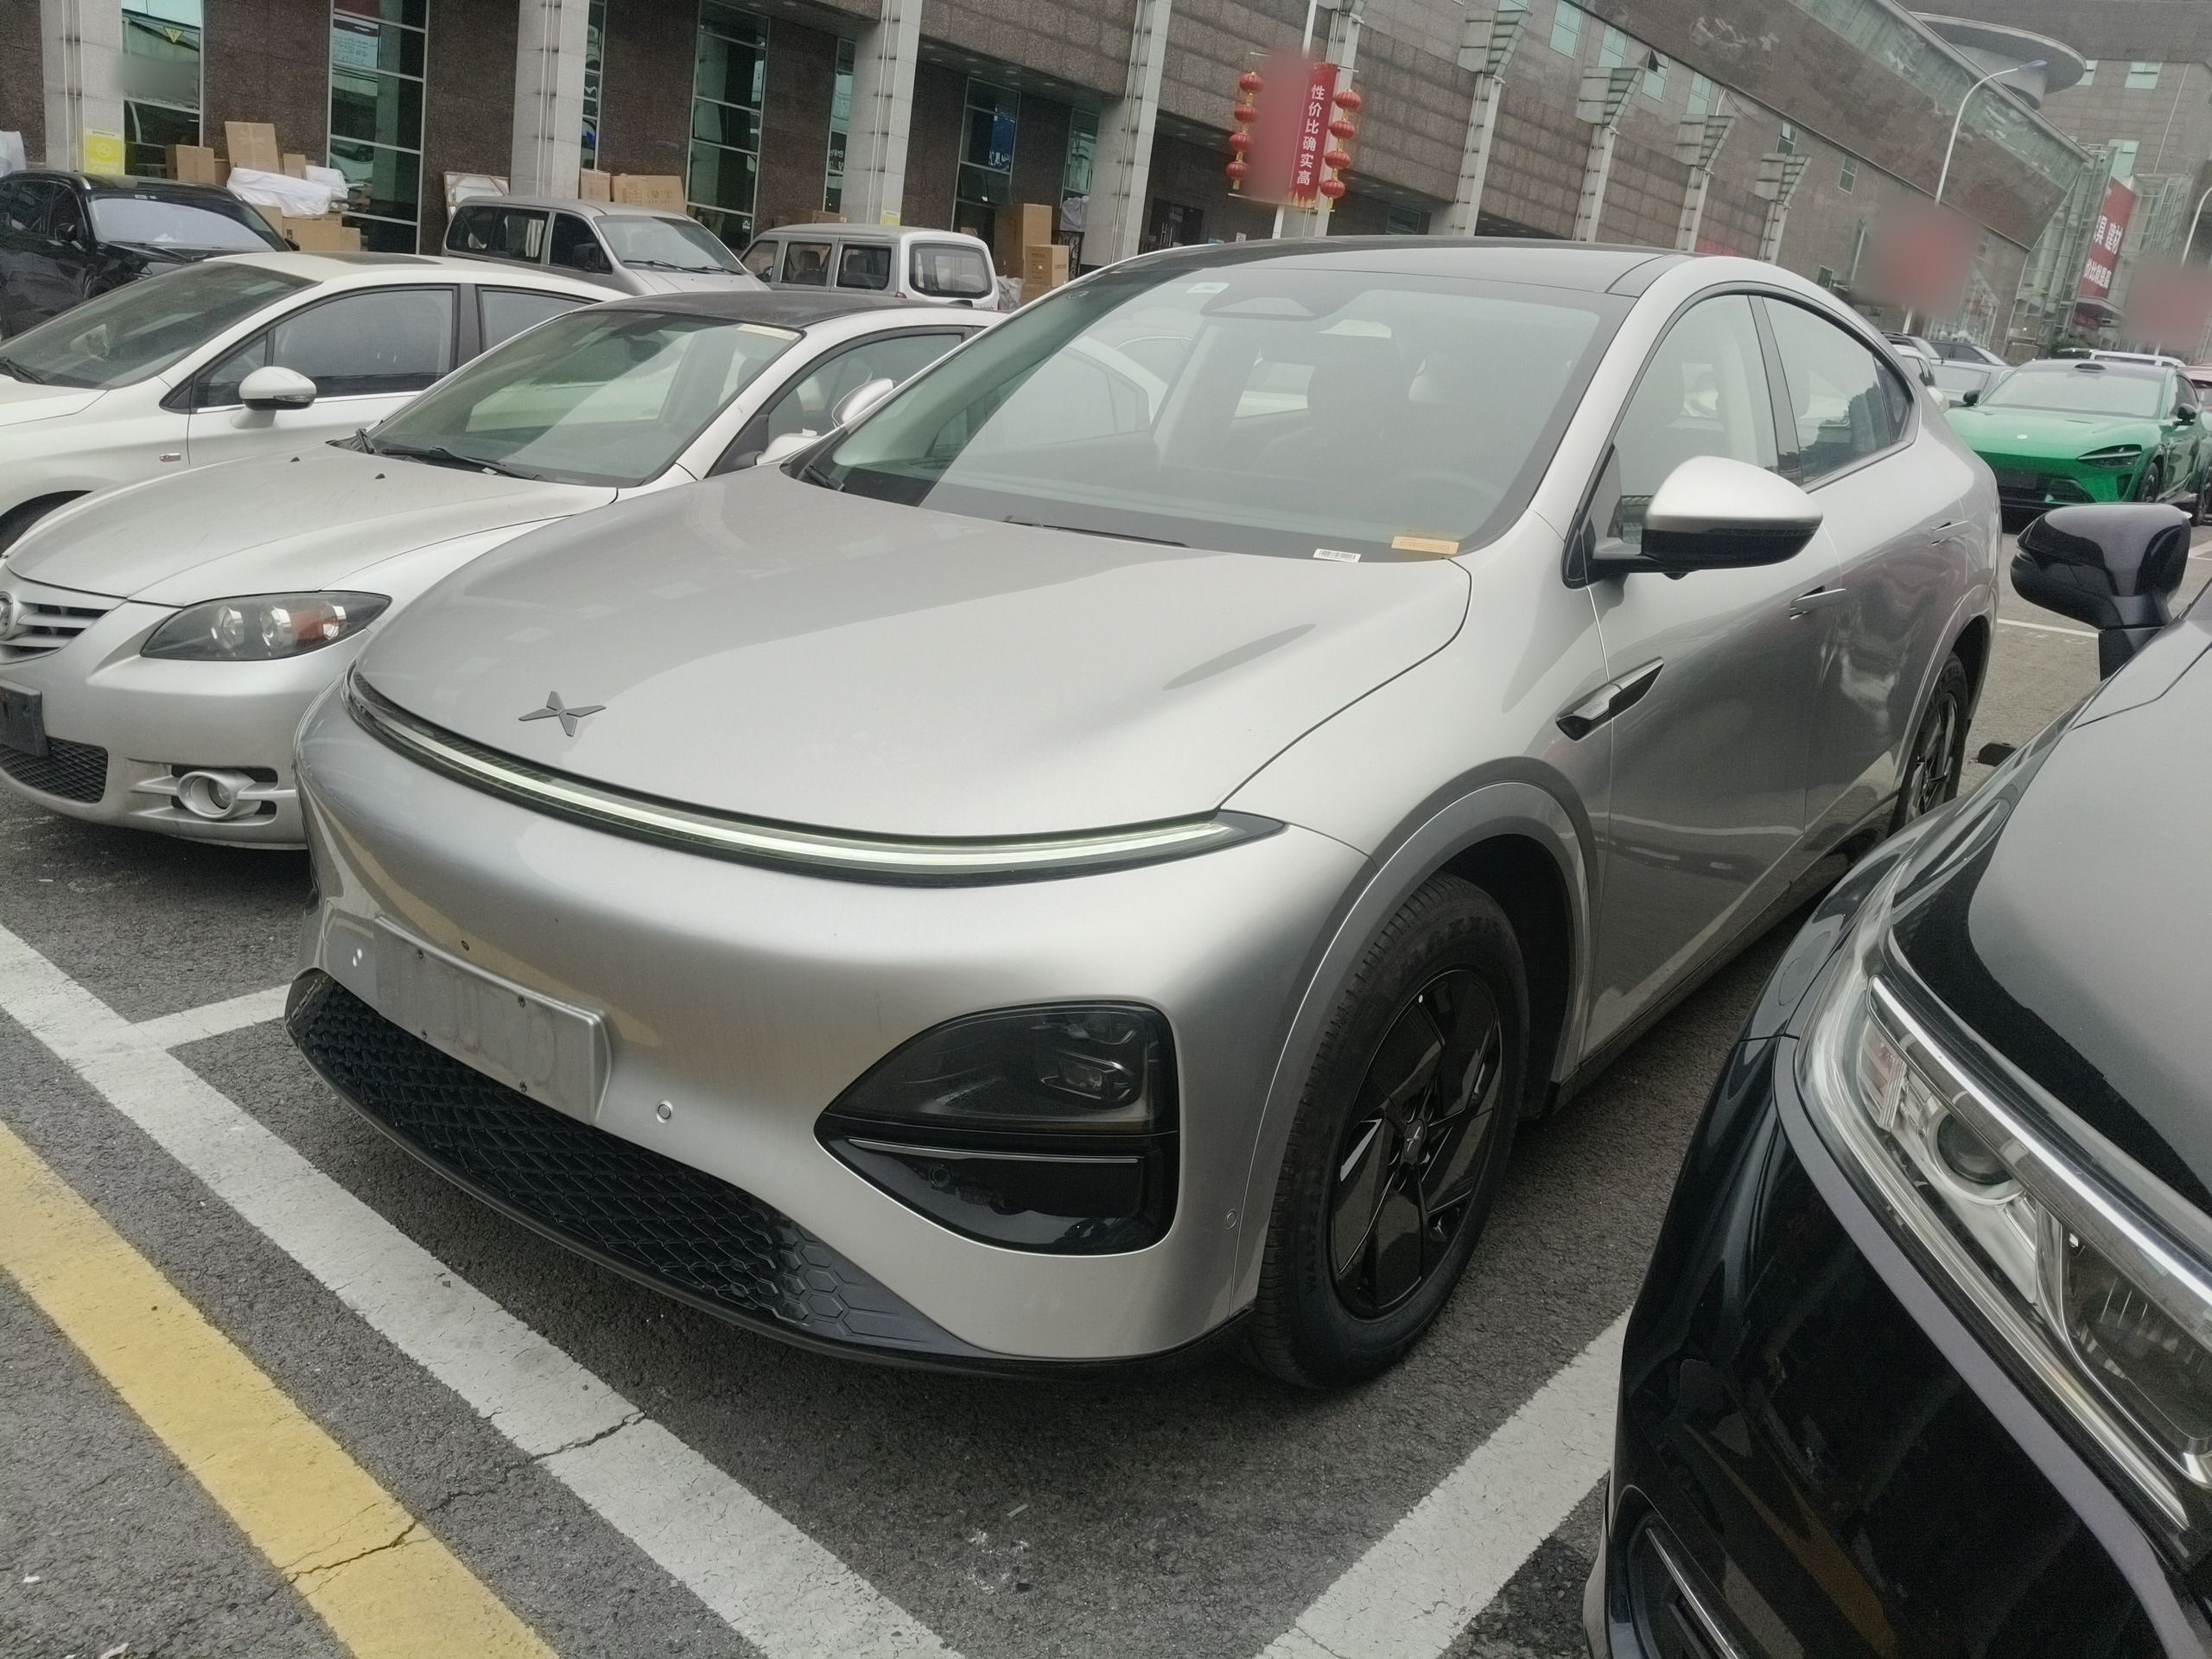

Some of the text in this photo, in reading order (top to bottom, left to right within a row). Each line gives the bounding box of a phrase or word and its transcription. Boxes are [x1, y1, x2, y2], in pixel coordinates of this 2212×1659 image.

[1297, 85, 1325, 185] 性价比确实高
